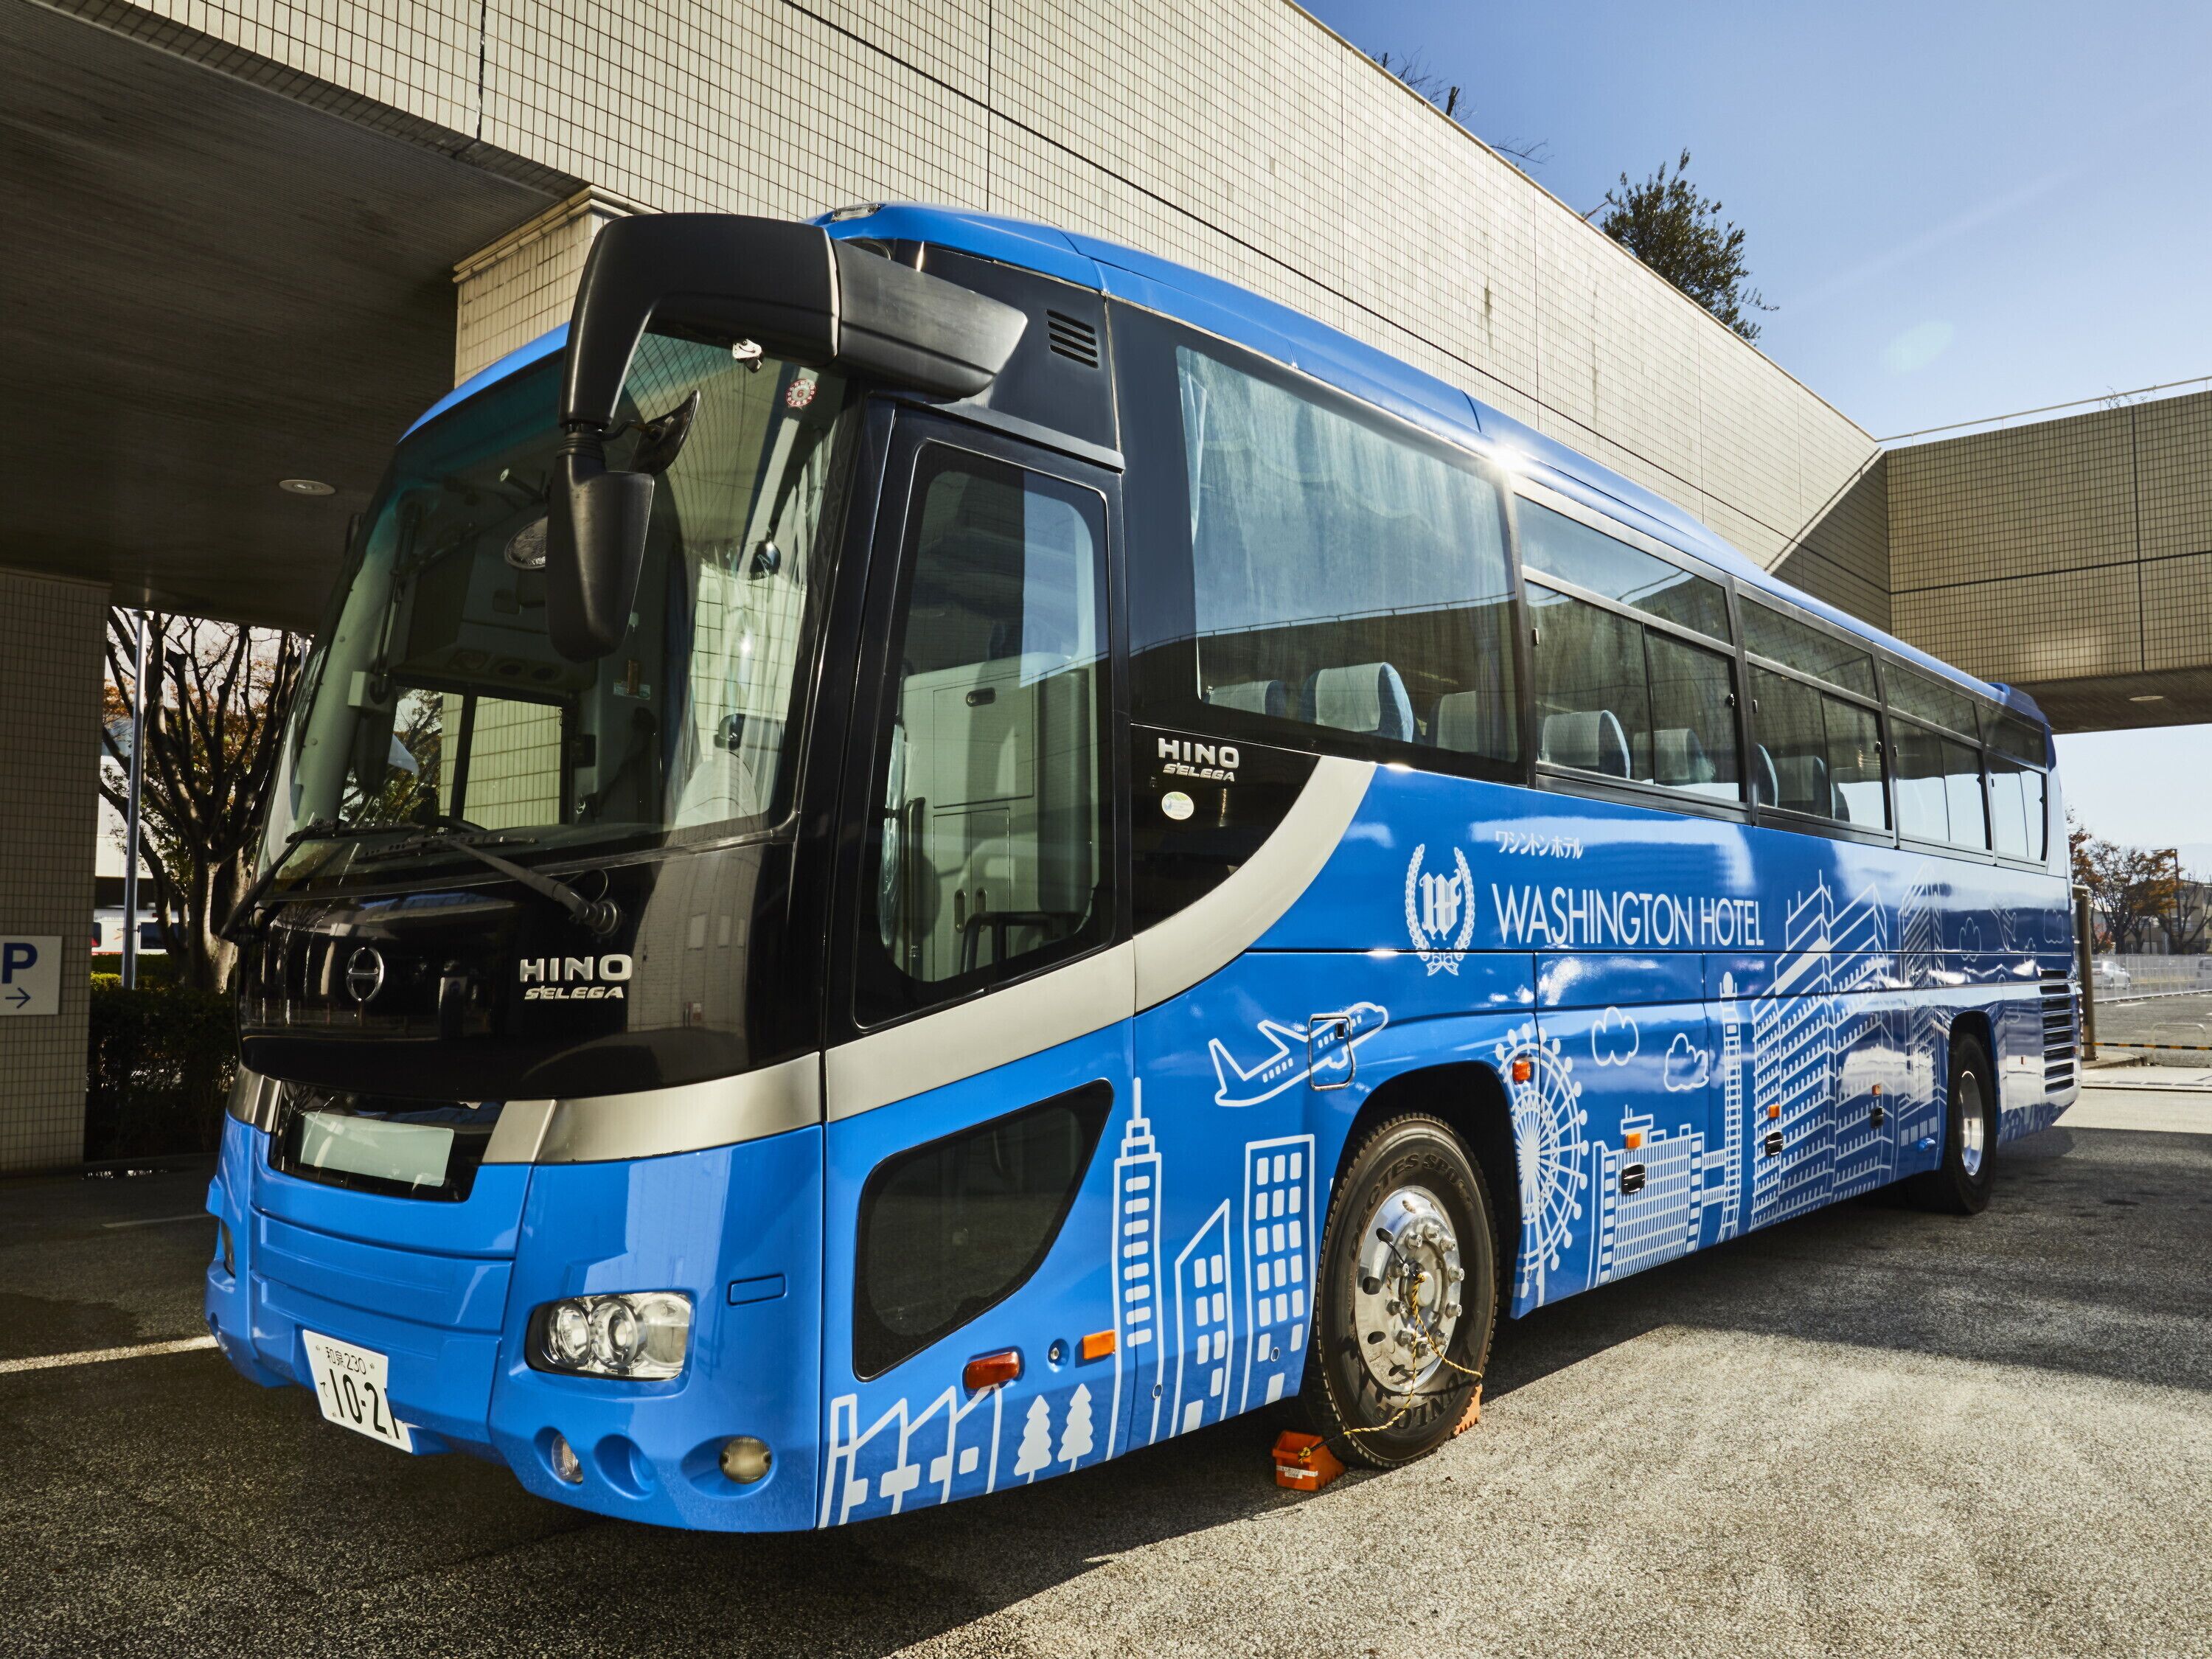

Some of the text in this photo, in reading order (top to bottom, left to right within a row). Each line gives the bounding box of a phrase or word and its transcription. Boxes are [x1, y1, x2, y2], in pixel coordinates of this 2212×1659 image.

[1158, 737, 1239, 769] HINO
[1495, 830, 1585, 860] ワシントンホテル
[1492, 883, 1764, 946] WASHINGTON HOTEL
[1, 942, 38, 984] P
[519, 953, 633, 983] HINO
